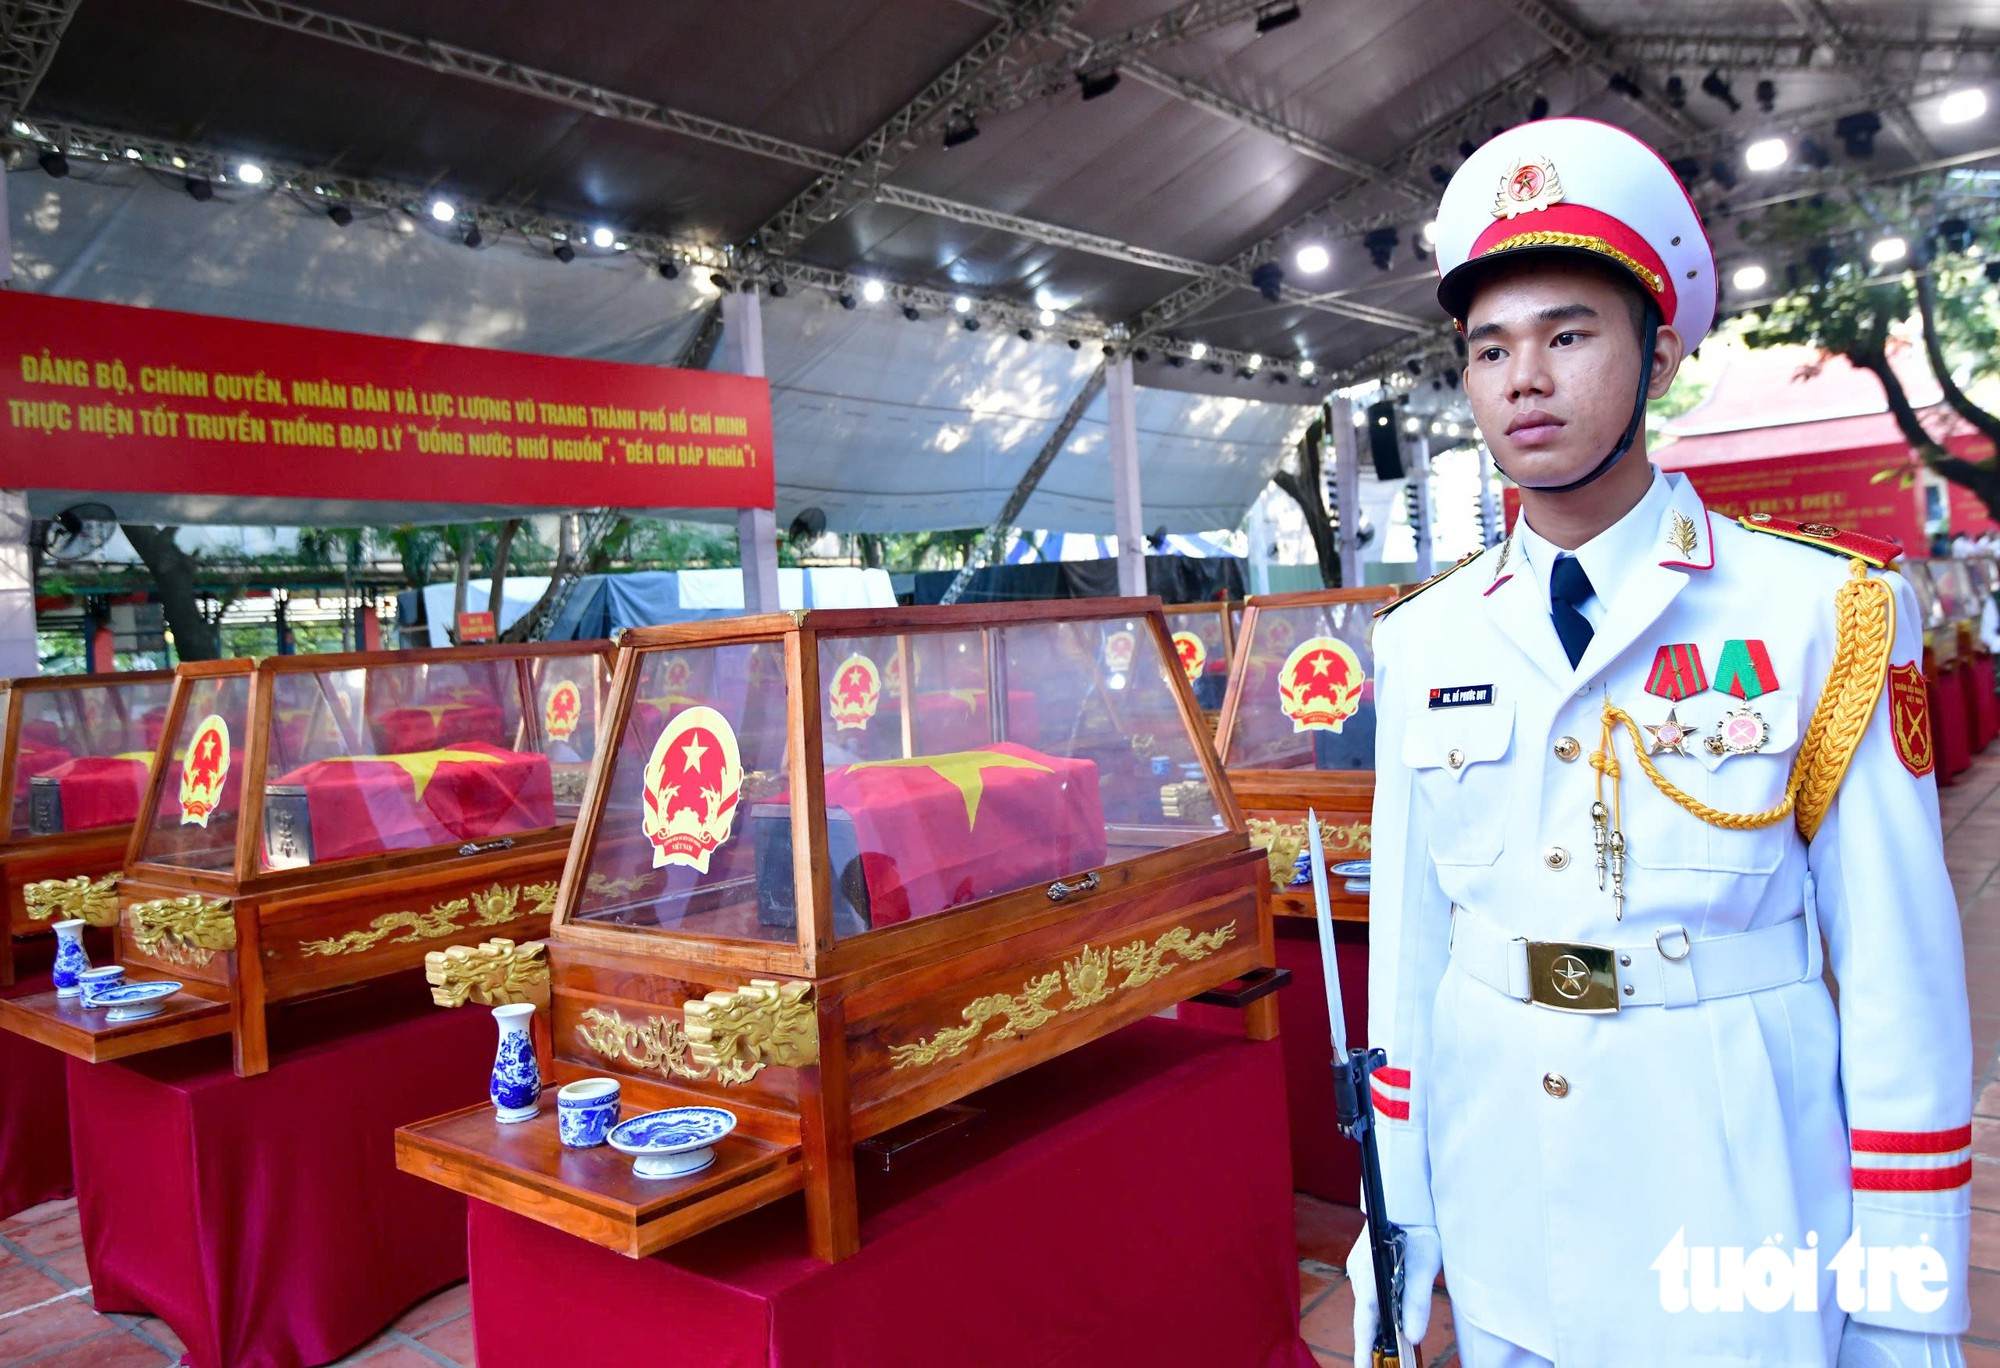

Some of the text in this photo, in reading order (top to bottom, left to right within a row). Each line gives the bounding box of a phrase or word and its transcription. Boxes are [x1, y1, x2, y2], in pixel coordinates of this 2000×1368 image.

[22, 347, 748, 437] ĐẢNG BỘ, CHÍNH QUYỀN, NHÂN DÂN VÀ LỰC LƯỢNG VŨ TRANG THÀNH PHỐ HỒ CHÍ MINH
[7, 399, 73, 435] THỰC
[78, 401, 134, 440] HIỆN
[139, 402, 179, 438] TỐT
[184, 409, 267, 443] TRUYỀN
[271, 413, 336, 448] THỐNG
[340, 423, 378, 454] ĐẠO
[381, 422, 403, 451] LÝ
[468, 430, 513, 458] NƯỚC
[516, 433, 549, 460] NHỚ
[656, 442, 676, 465] ƠN
[678, 441, 704, 466] ĐÁP
